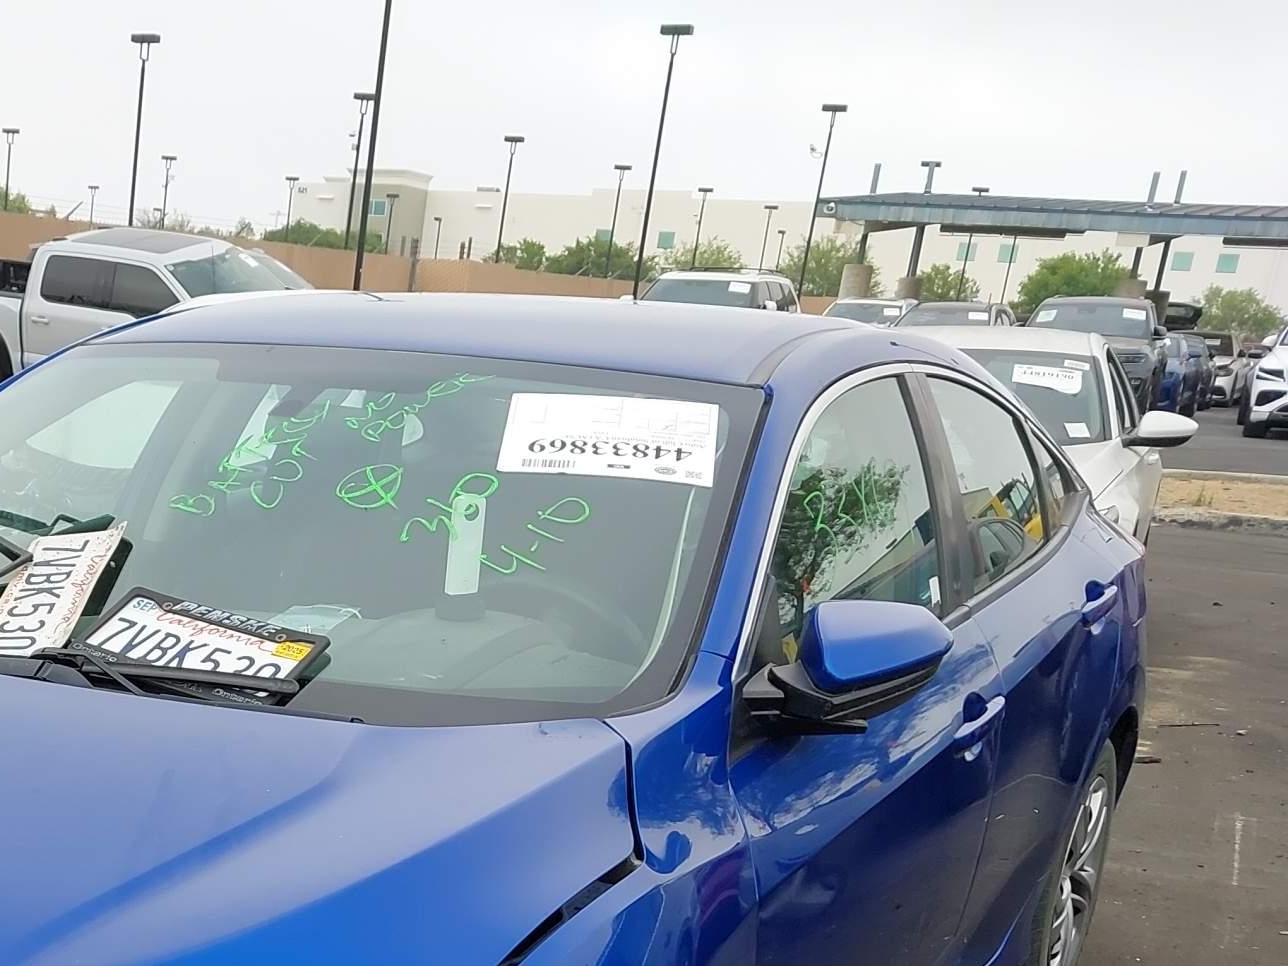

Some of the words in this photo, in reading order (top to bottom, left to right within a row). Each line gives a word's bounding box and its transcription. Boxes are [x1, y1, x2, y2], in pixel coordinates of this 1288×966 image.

[527, 437, 695, 462] 44833869
[479, 496, 591, 575] 4-10
[132, 597, 157, 613] SEP
[172, 600, 283, 636] PENSKE
[156, 611, 275, 652] California
[71, 641, 118, 664] Ontario
